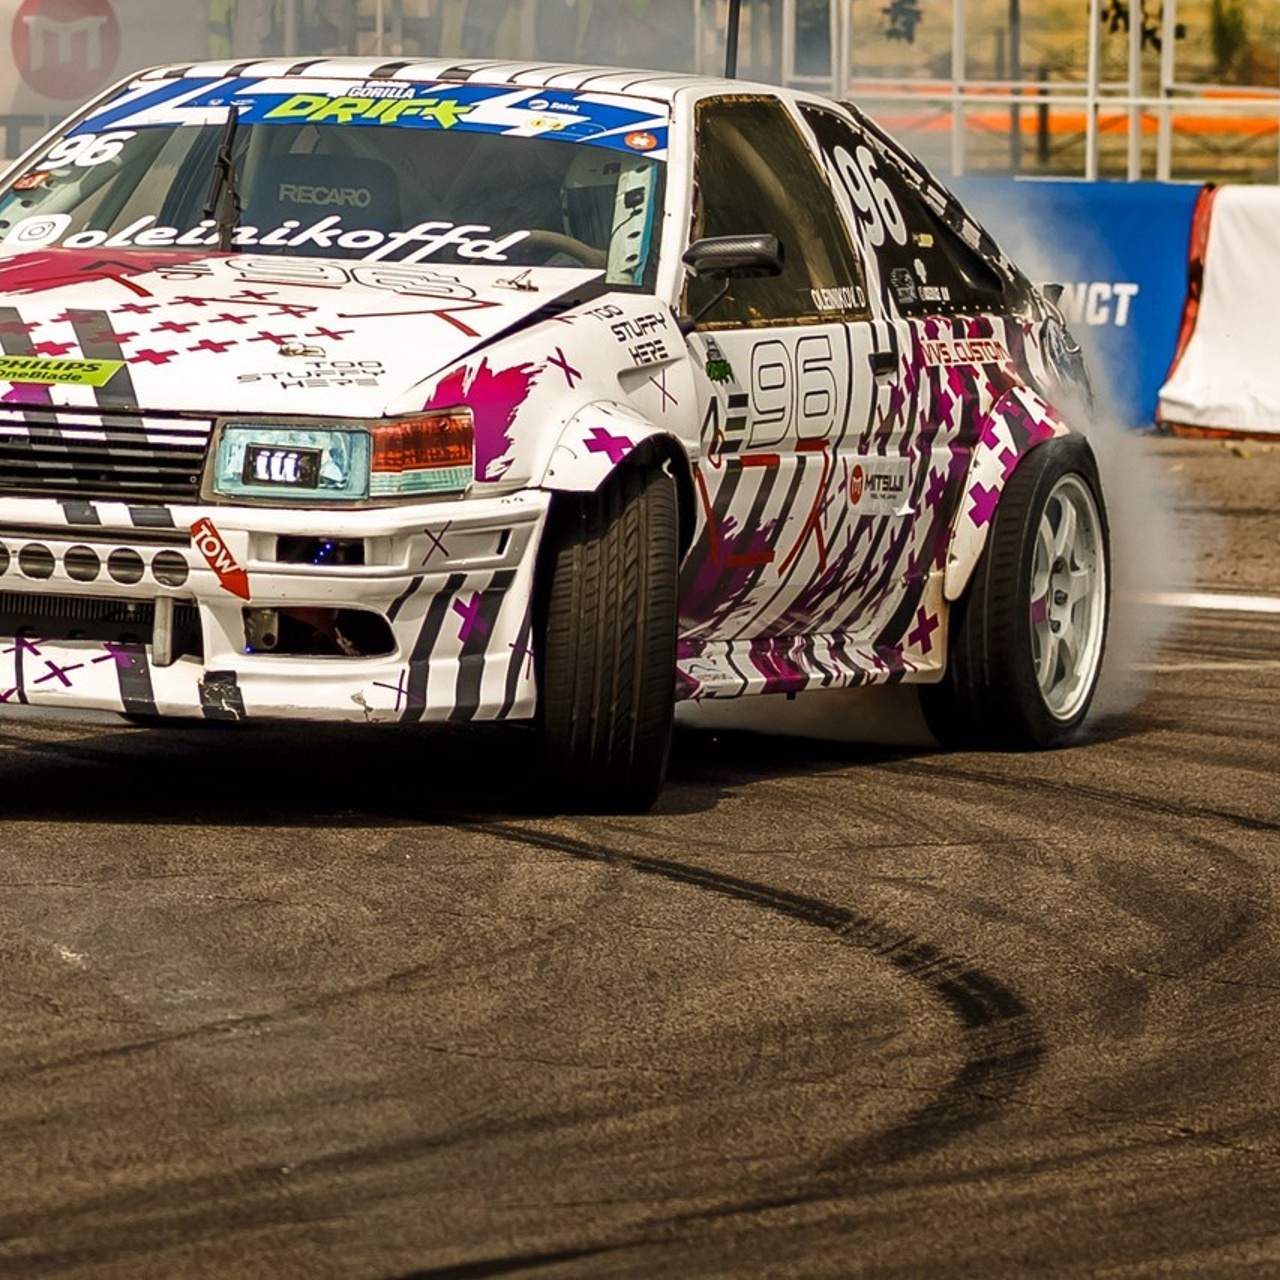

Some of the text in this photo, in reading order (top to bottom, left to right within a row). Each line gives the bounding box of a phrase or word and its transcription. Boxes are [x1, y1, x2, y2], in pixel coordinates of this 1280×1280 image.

[348, 86, 416, 100] GORILLA
[263, 94, 473, 129] DRIFT
[35, 130, 138, 171] 96
[278, 183, 372, 208] RECARO
[833, 145, 908, 247] 96
[583, 304, 624, 321] TOO
[610, 312, 668, 342] STUFFY
[305, 360, 383, 369] TOO
[628, 339, 669, 367] HERE
[236, 369, 386, 383] STUFFY
[280, 378, 380, 390] HERE
[193, 524, 240, 574] TOW
